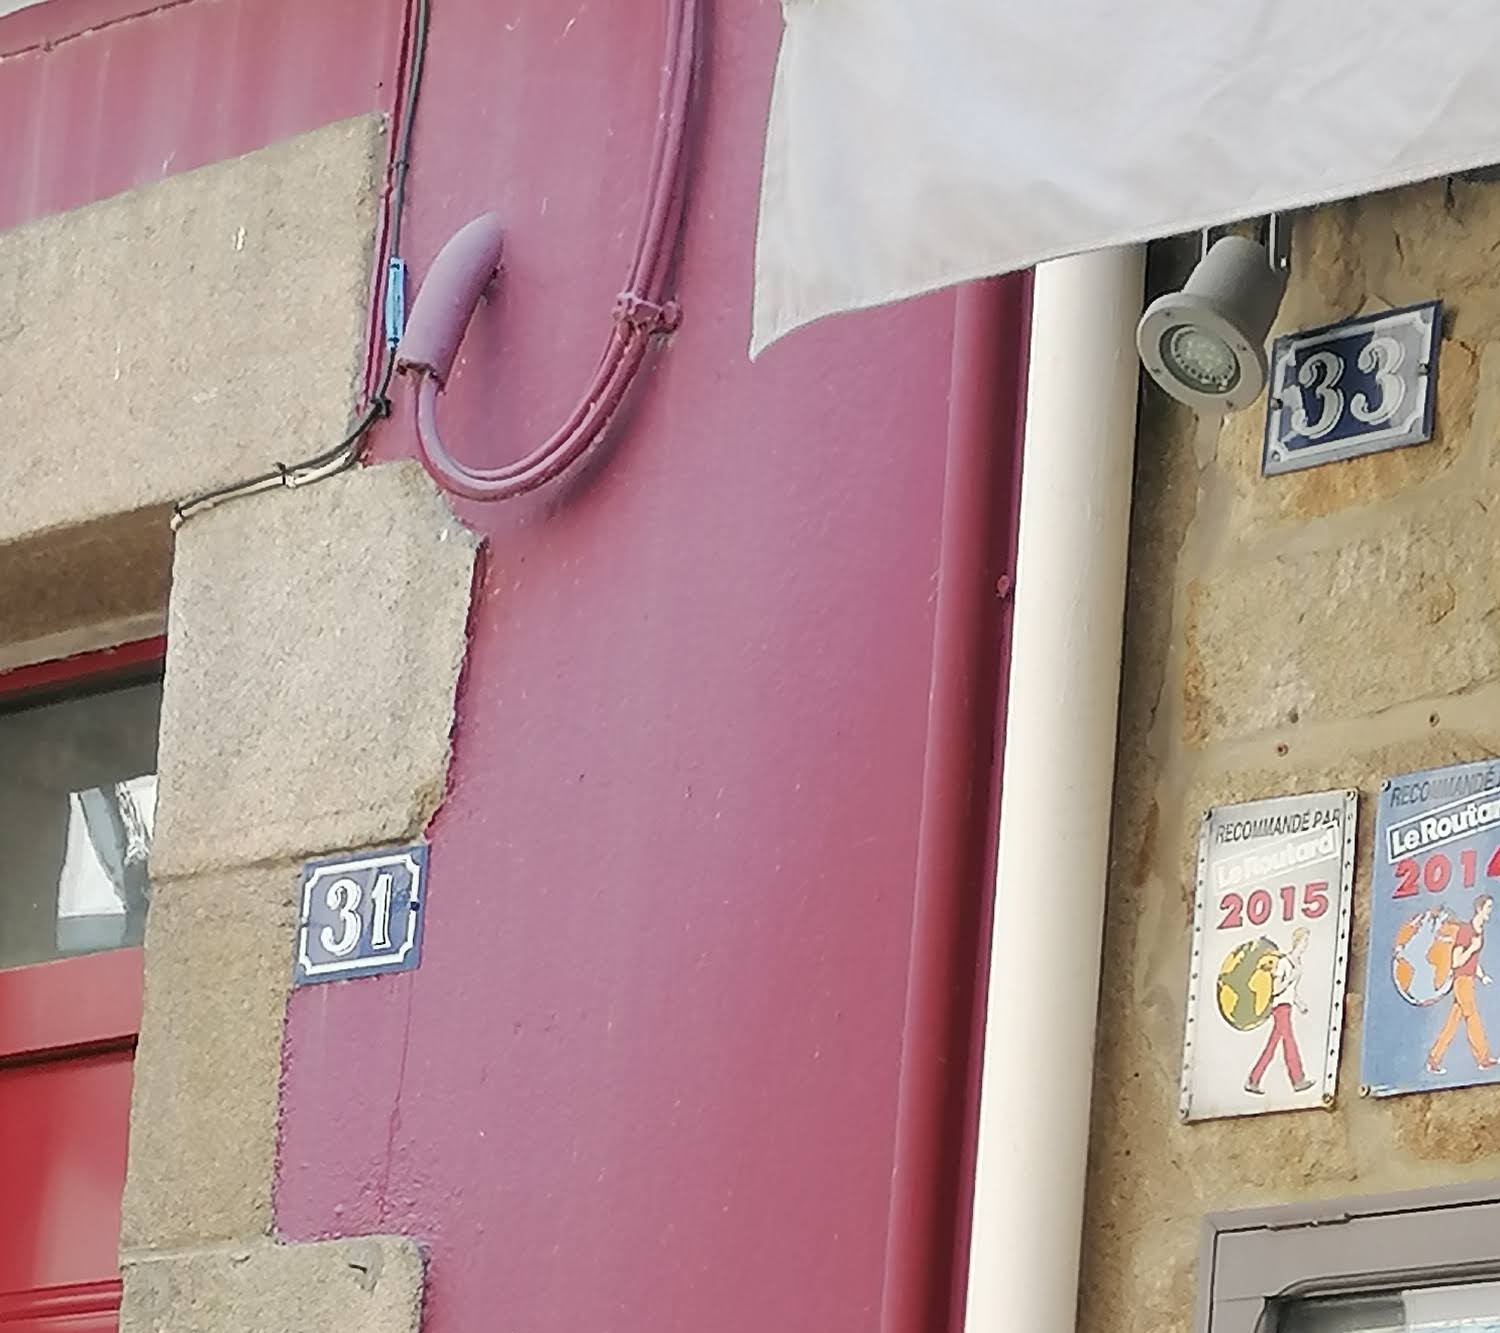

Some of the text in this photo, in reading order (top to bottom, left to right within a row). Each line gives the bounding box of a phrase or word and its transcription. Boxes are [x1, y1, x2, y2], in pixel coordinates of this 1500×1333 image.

[1291, 337, 1406, 439] 33
[1312, 808, 1342, 831] PAR
[1392, 829, 1420, 856] Le
[321, 873, 393, 957] 31
[1216, 881, 1329, 930] 2015
